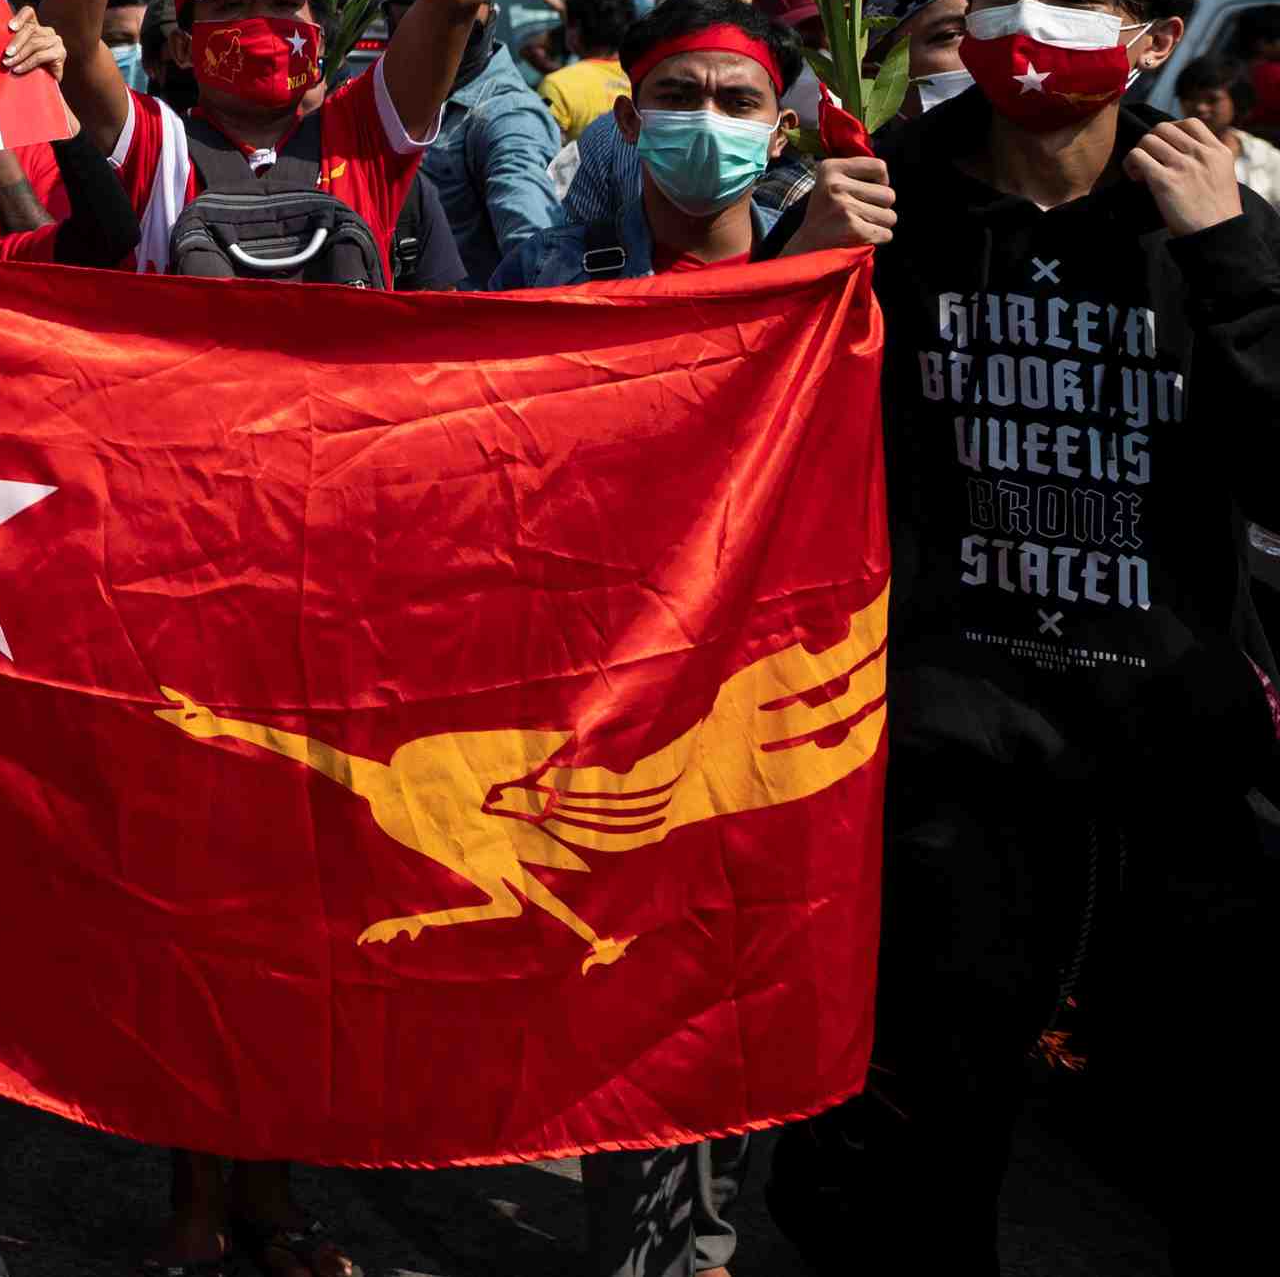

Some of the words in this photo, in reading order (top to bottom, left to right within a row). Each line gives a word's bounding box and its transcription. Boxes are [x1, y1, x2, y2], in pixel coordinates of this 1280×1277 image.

[286, 72, 307, 91] NLD
[938, 291, 1157, 360] HARLEM
[918, 348, 1185, 429] BROOKLYN
[954, 416, 1152, 486] QUEENS
[967, 476, 1144, 550] BRONX
[960, 534, 1152, 611] STATEN
